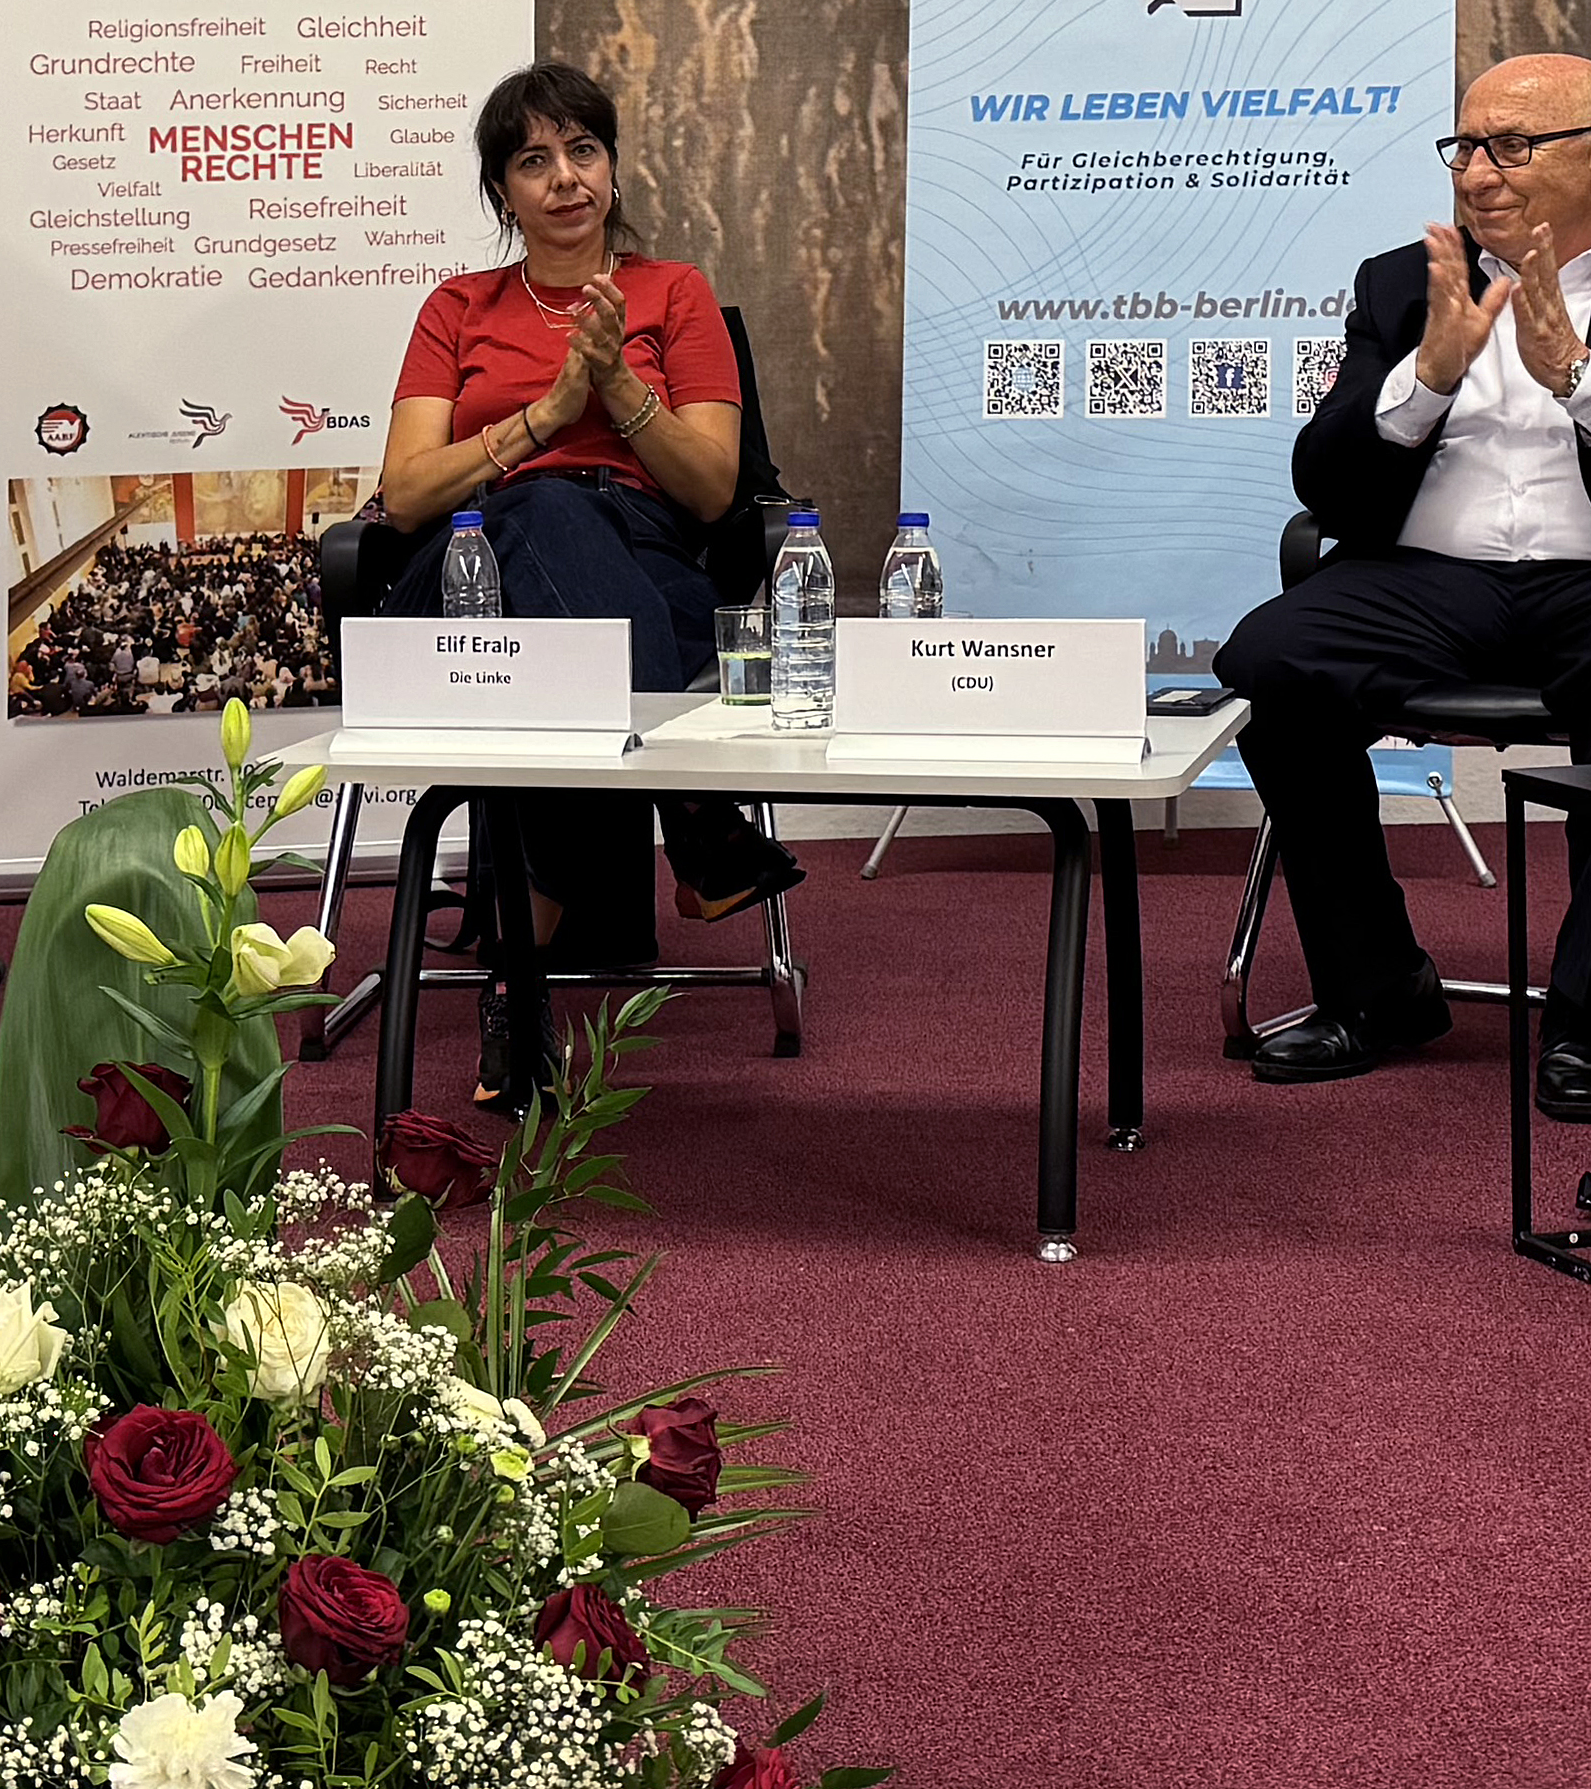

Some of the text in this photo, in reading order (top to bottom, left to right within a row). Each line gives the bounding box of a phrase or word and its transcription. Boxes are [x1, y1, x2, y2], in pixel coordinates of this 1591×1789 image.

[89, 15, 427, 43] Religionsfreiheit Gleichheit
[30, 51, 416, 75] Grundrechte Freiheit Recht
[85, 87, 467, 113] Staat Anerkennung Sicherheit
[970, 86, 1402, 122] WIR LEBEN VIELFALT!
[29, 123, 454, 153] Herkunft MENSCHEN Glaube
[53, 152, 443, 182] Gesetz RECHTE Liberalität
[1022, 148, 1335, 169] Für Gleichberechtigung,
[97, 181, 162, 197] Vielfalt
[1007, 169, 1350, 193] Partizipation & Solidarität
[30, 195, 407, 230] Gleichstellung Reisefreiheit
[51, 229, 445, 257] Pressefreiheit Grundgesetz Wahrheit
[72, 265, 222, 290] Demokratie
[327, 415, 370, 428] BDAS
[437, 636, 520, 657] Elif Eralp
[912, 640, 1055, 657] Kurt Wansner
[450, 672, 511, 684] Die Linke
[952, 676, 993, 691] (CDU)
